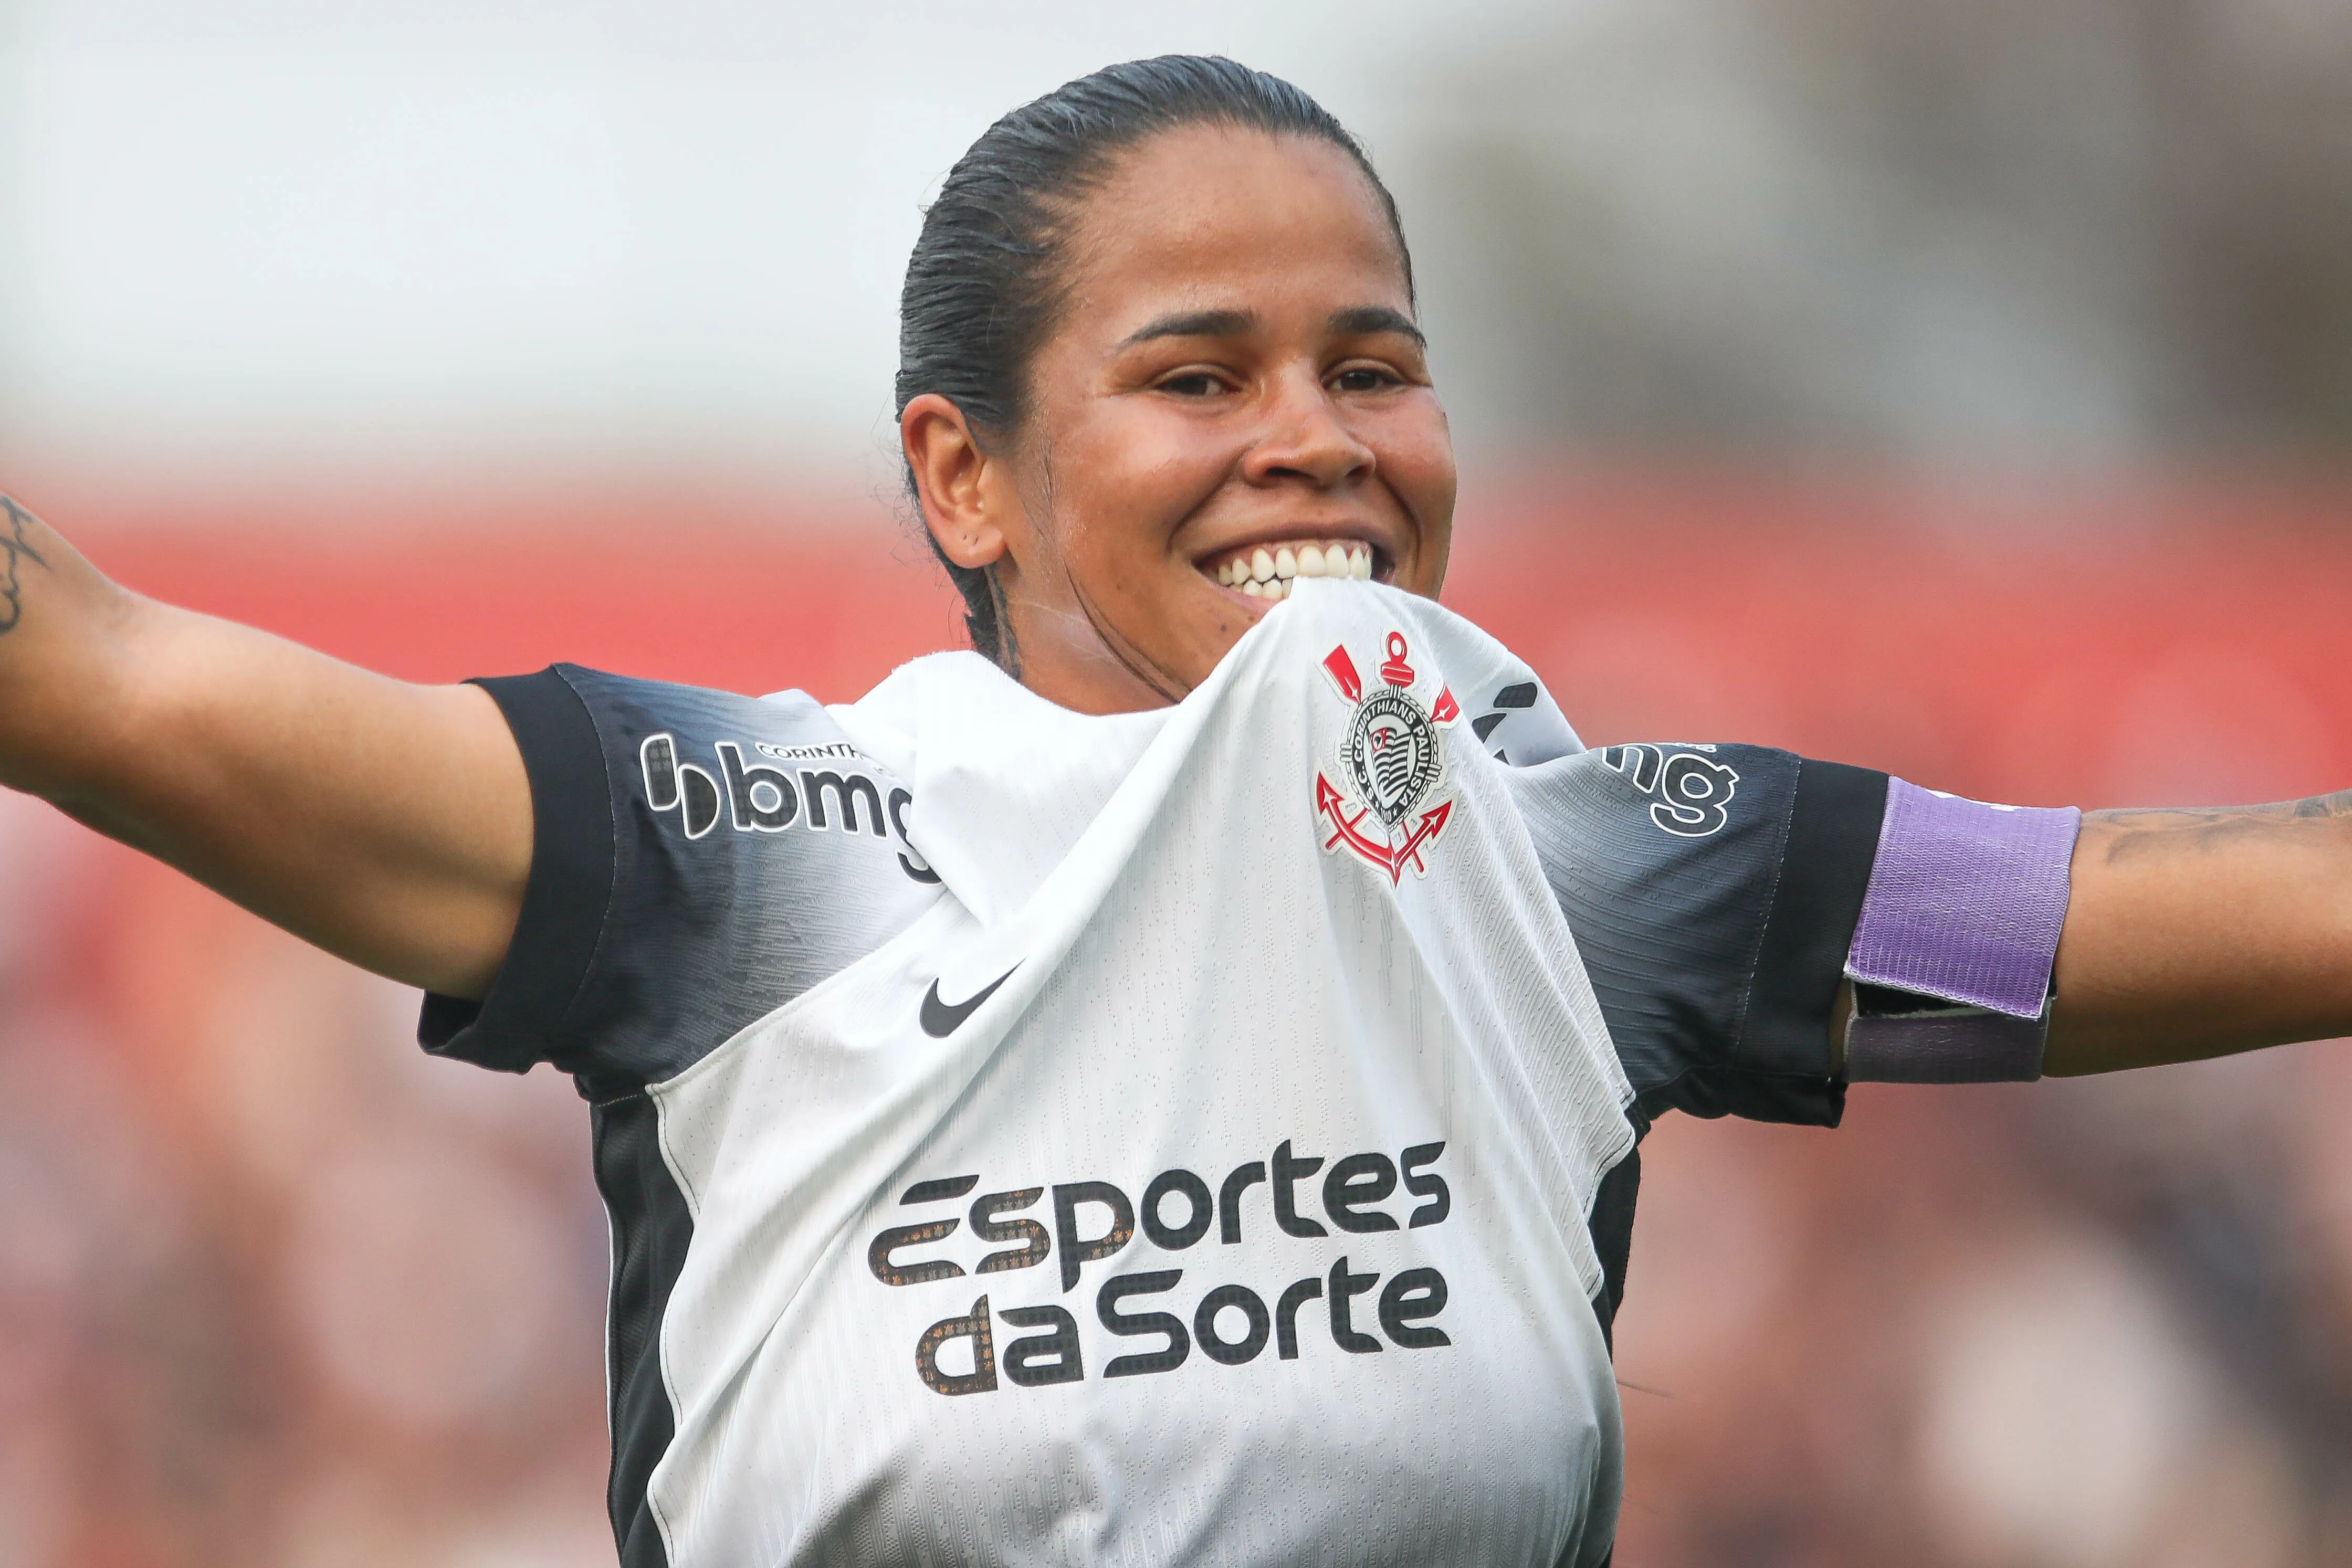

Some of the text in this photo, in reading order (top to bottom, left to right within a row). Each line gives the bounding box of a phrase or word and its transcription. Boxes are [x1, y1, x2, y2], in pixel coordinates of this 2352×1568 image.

[1353, 700, 1416, 762] CORINTHIANS
[1399, 724, 1431, 807] PAULISTA
[867, 1139, 1451, 1293] Esportes
[915, 1256, 1452, 1397] da Sorte
